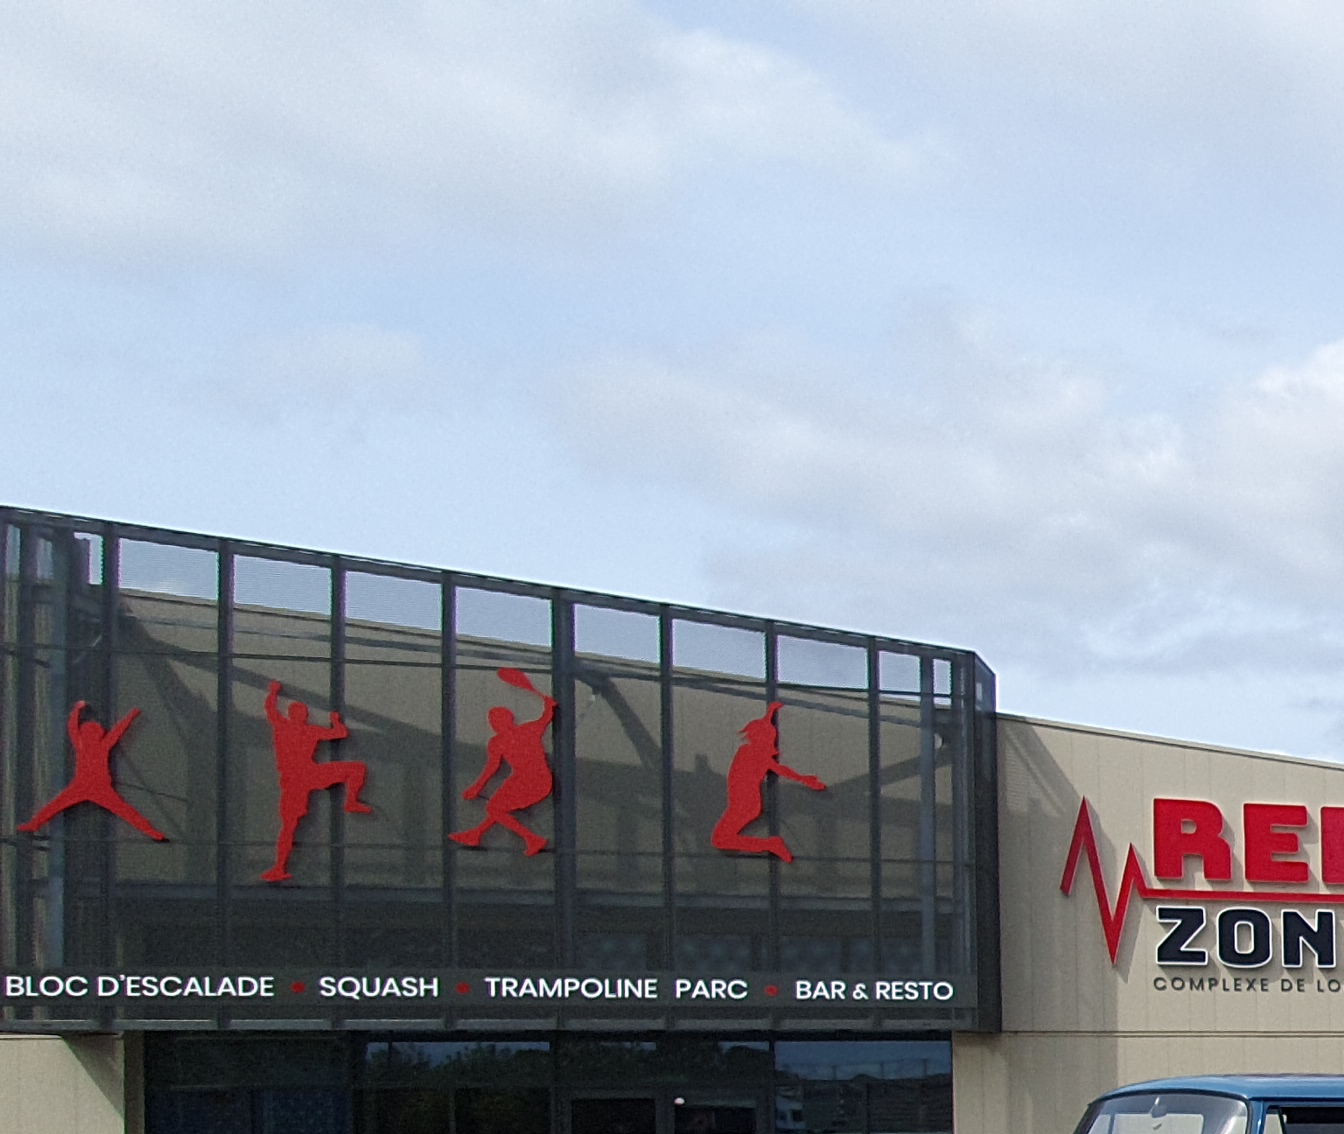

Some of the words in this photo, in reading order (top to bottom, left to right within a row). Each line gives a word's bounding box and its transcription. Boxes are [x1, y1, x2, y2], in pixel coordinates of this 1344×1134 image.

[5, 975, 88, 998] BLOC
[97, 973, 274, 998] D'ESCALADE
[319, 976, 438, 999] SQUASH
[484, 976, 658, 999] TRAMPOLINE
[675, 978, 748, 1000] PARC
[795, 980, 846, 1000] BAR
[852, 983, 865, 1001] &
[875, 981, 955, 1001] RESTO
[1153, 976, 1269, 993] COMPLEXE
[1281, 978, 1305, 993] DE
